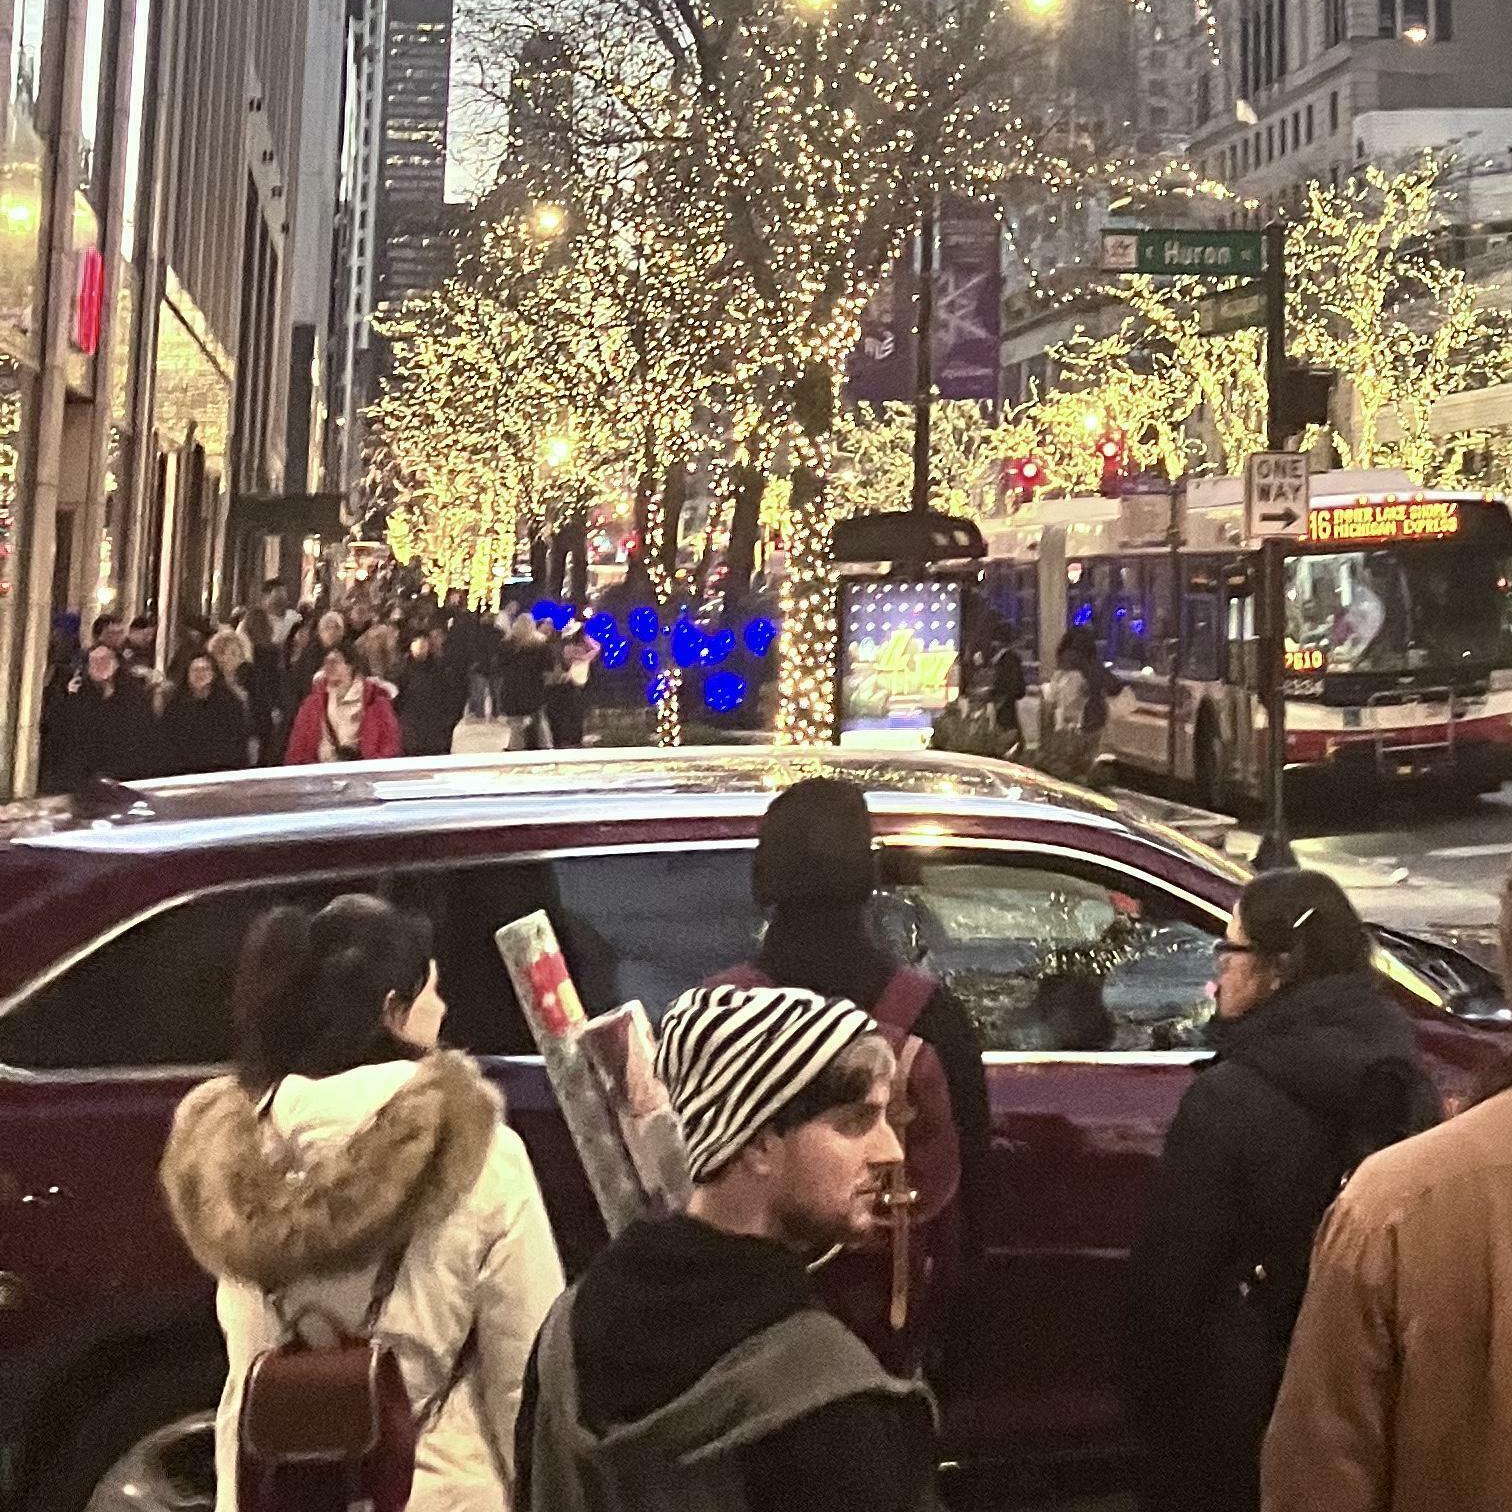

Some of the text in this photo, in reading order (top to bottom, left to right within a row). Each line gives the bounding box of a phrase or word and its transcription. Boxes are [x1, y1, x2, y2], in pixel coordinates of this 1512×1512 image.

[1164, 240, 1232, 265] Huron
[1256, 459, 1303, 479] ONE
[1257, 482, 1303, 503] WAY
[1334, 519, 1397, 539] MICHIGAN
